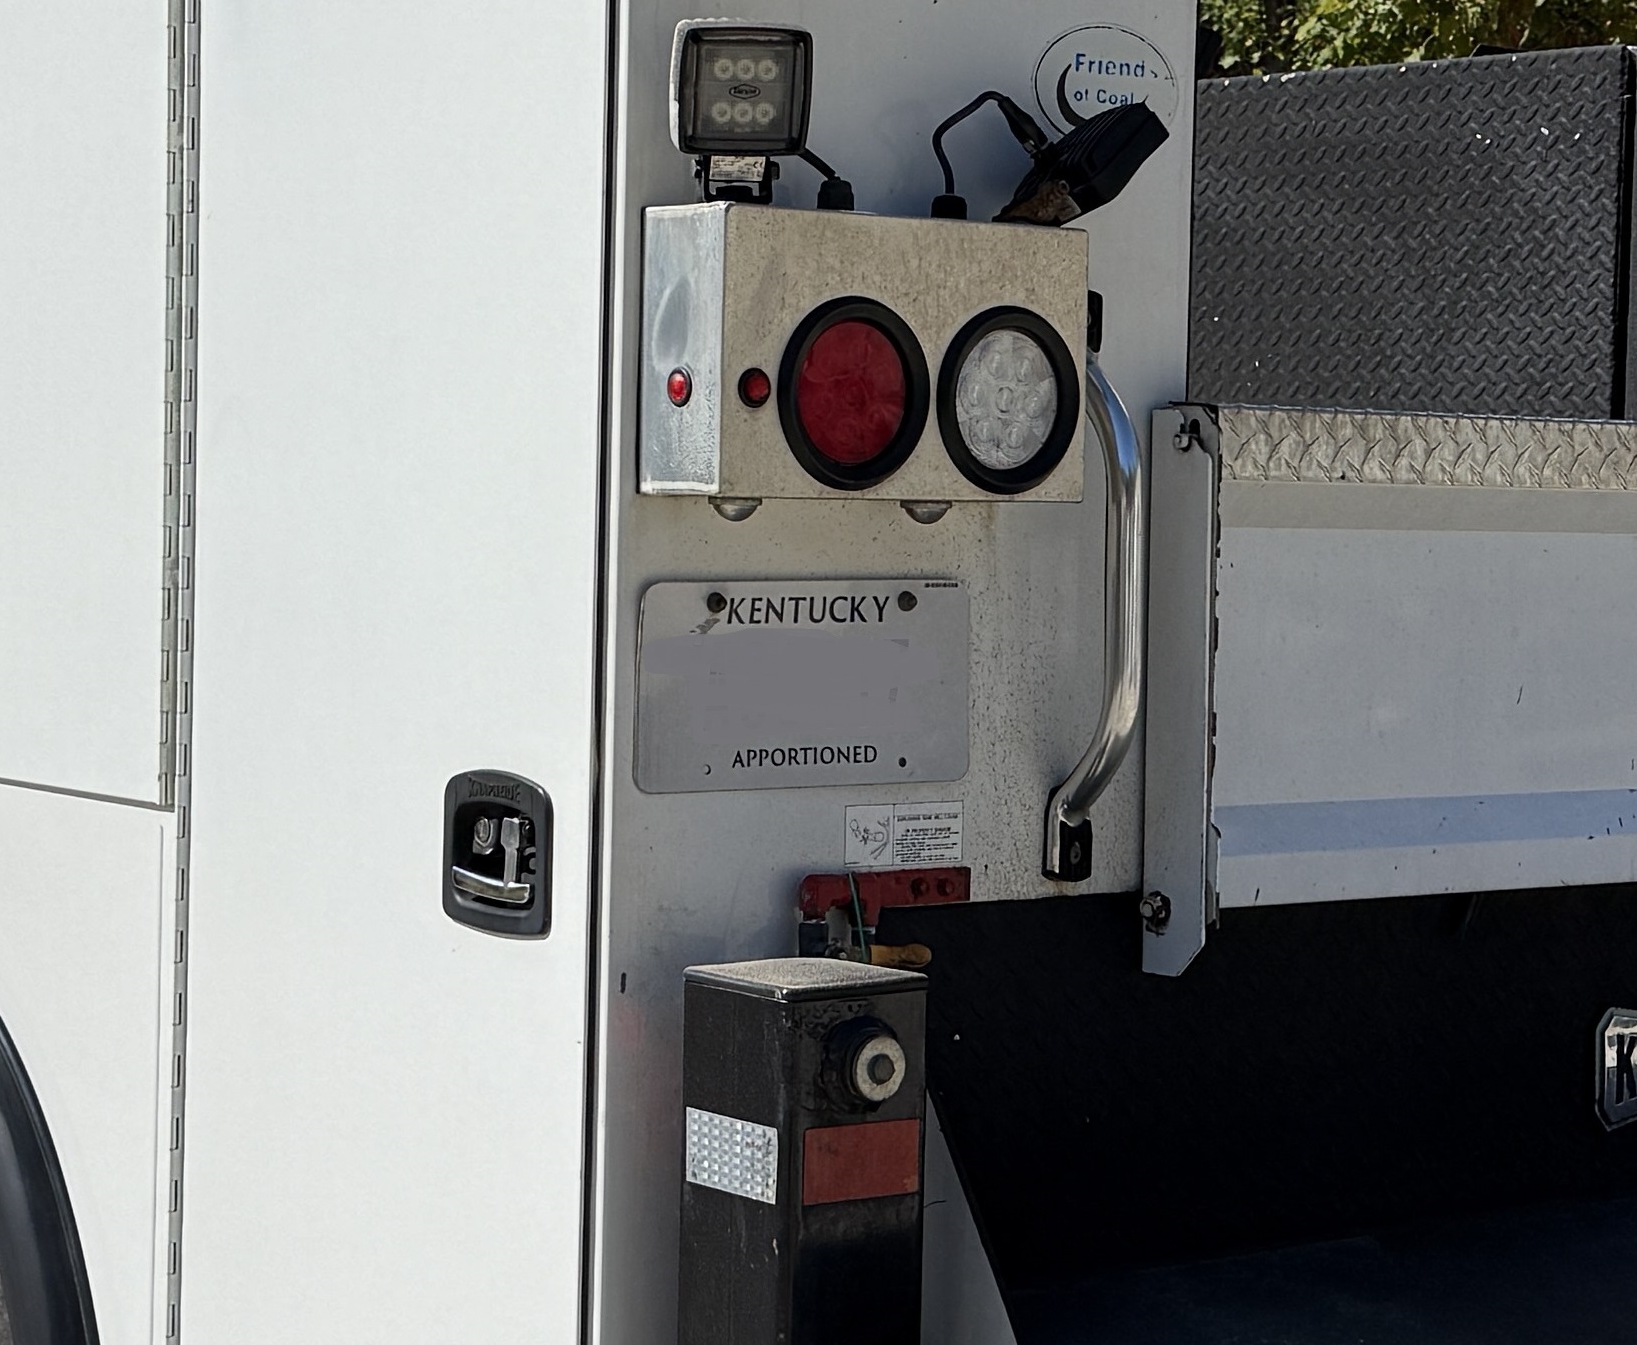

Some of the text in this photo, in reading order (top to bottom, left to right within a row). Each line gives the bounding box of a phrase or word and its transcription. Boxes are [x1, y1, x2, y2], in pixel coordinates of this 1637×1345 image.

[1074, 53, 1158, 79] Friend
[1073, 88, 1135, 106] of Coal
[726, 595, 890, 625] KENTUCKY
[731, 745, 878, 769] APPORTIONED
